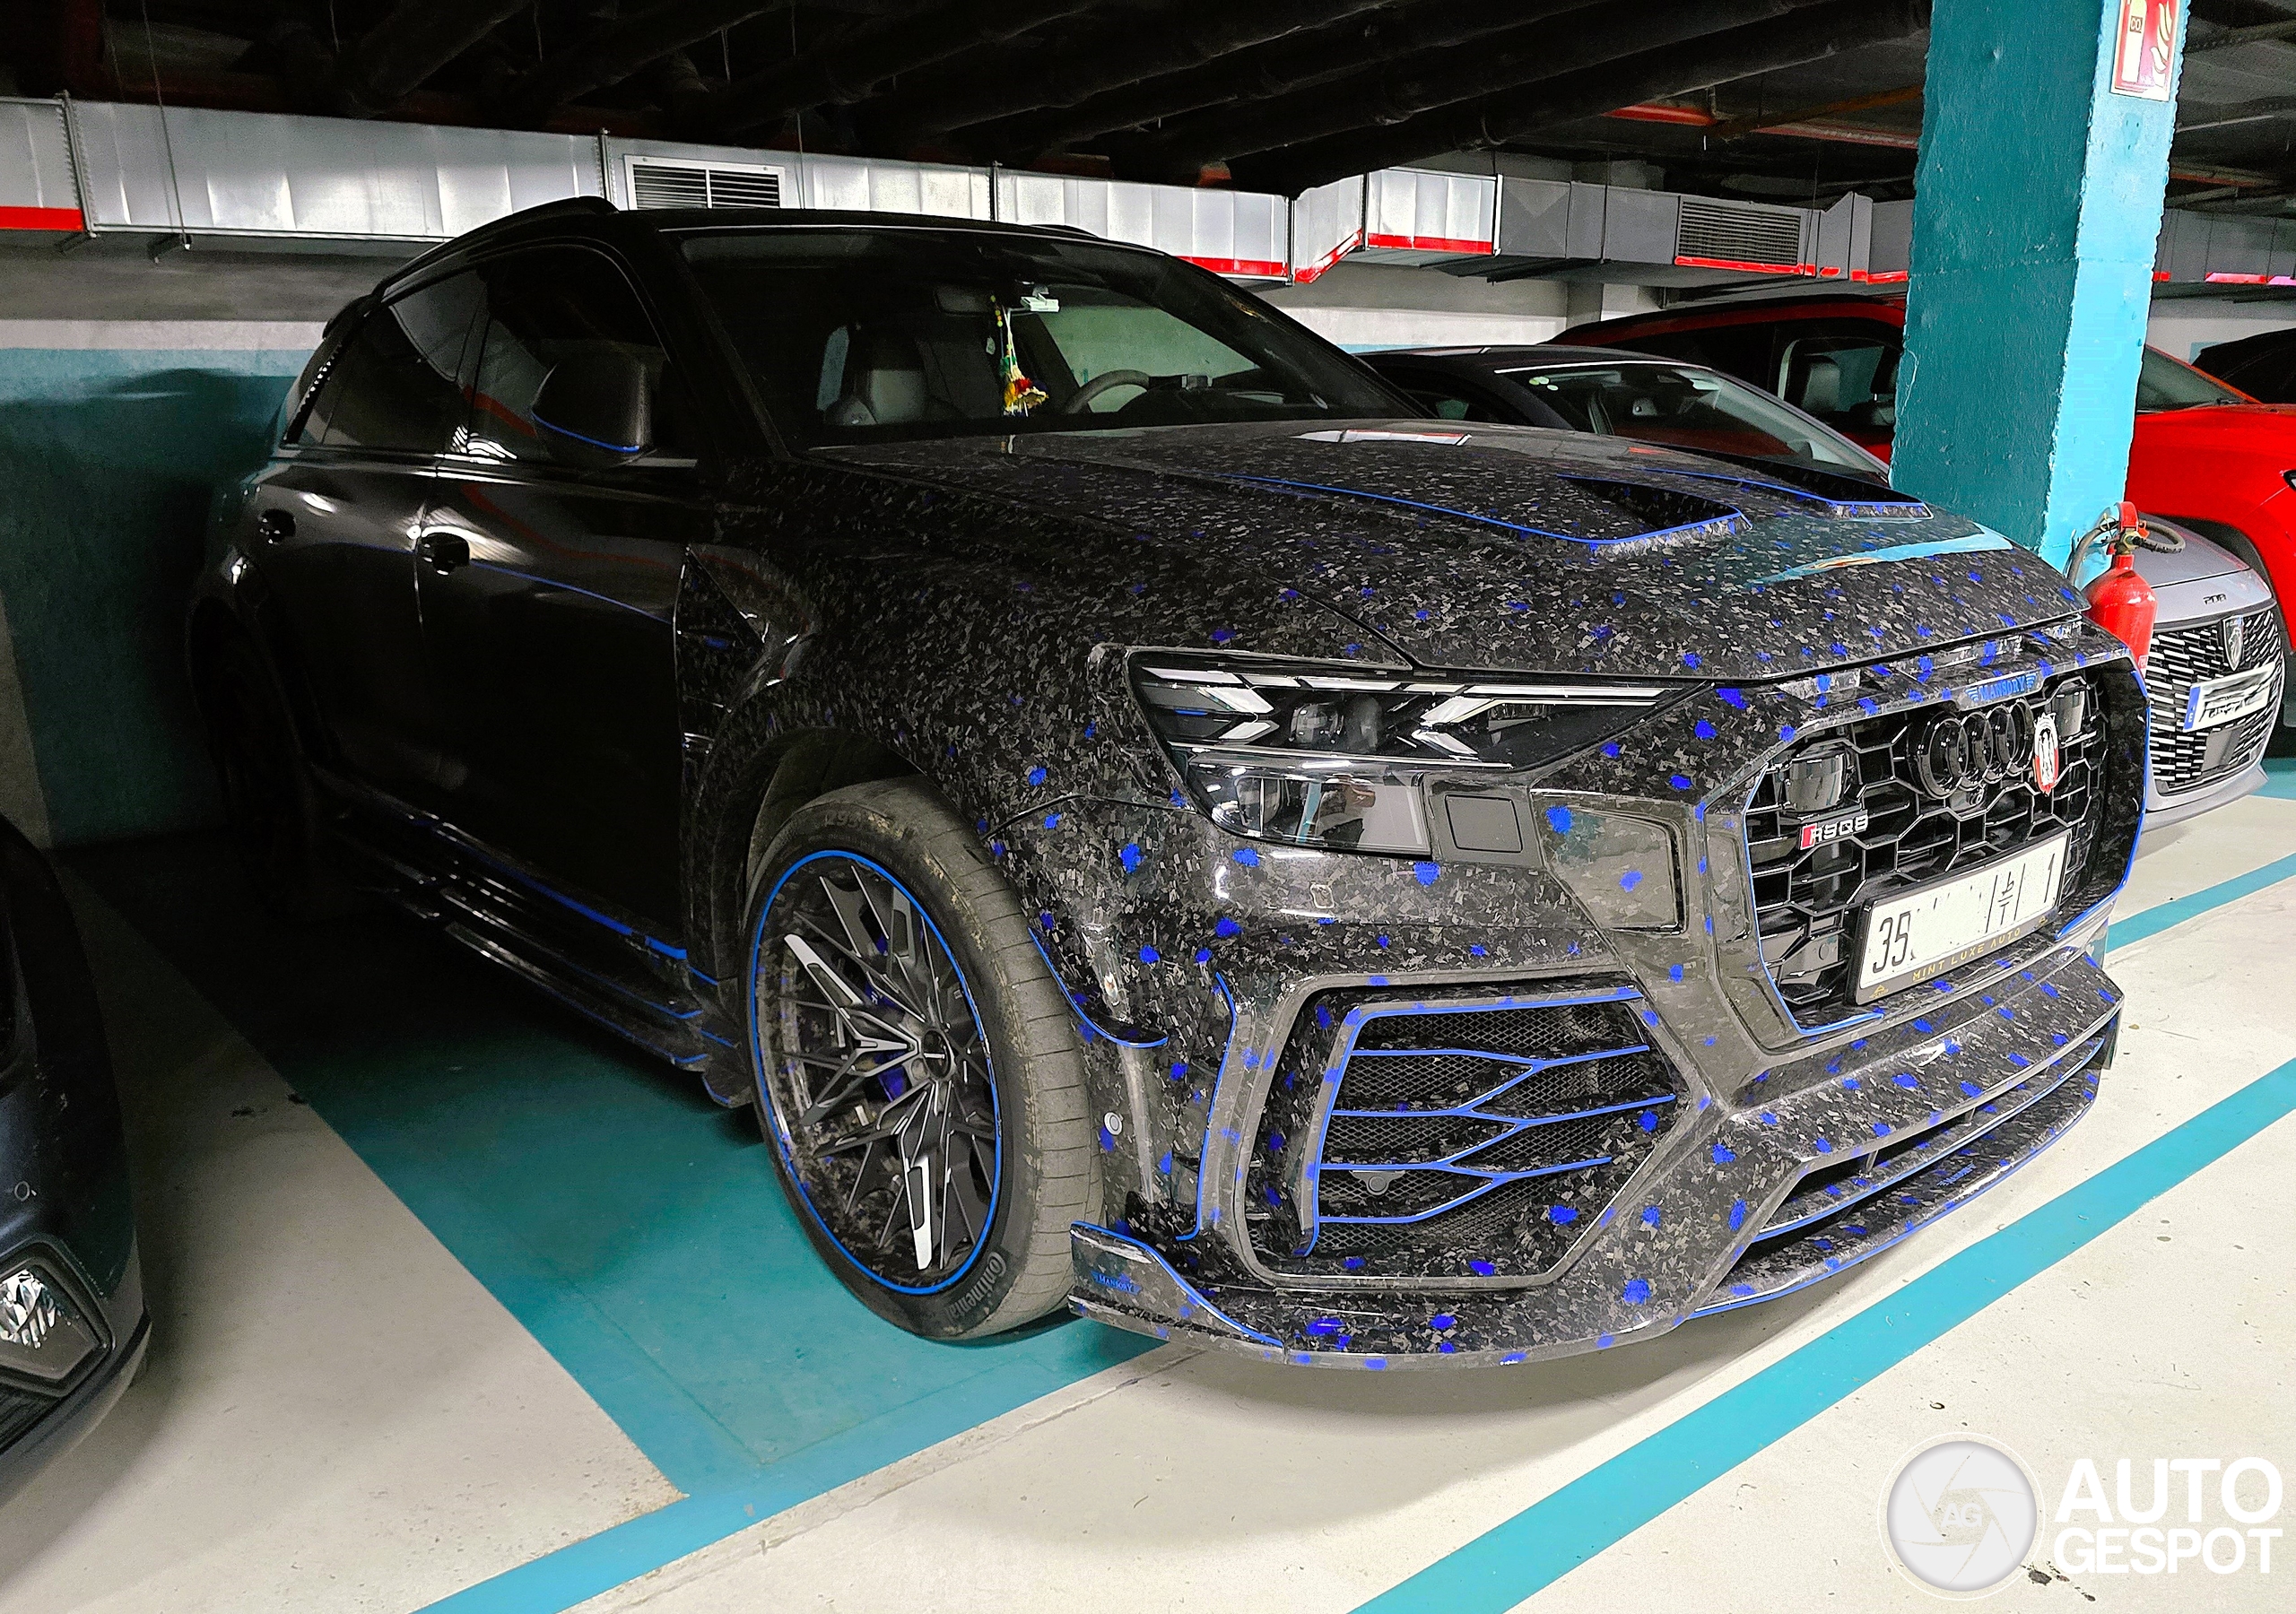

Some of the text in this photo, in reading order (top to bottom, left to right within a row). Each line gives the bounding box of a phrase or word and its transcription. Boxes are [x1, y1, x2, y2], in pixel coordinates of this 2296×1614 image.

[1979, 676, 2026, 701] MANSORY
[1801, 814, 1868, 849] RSQ8
[1912, 927, 2022, 983] MINT LUXE AUTO
